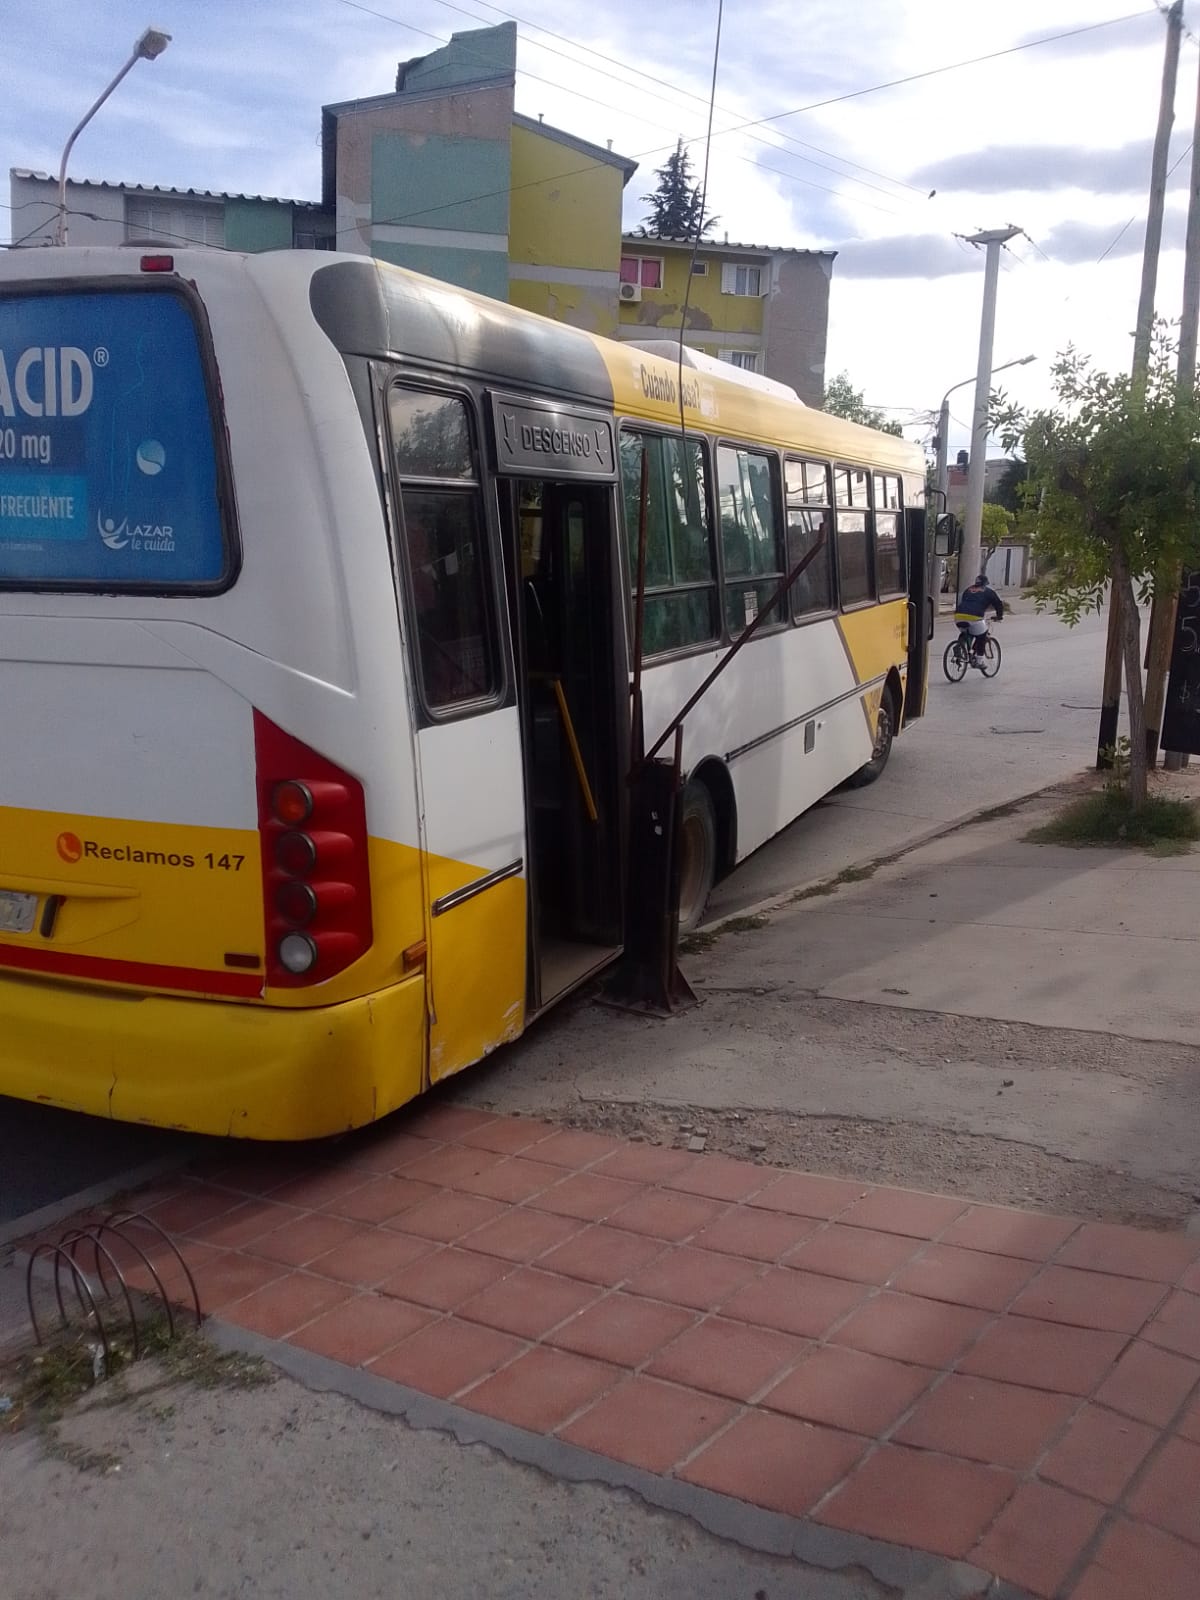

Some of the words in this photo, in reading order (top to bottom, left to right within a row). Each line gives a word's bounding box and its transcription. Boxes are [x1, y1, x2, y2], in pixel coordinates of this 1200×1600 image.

[22, 434, 50, 464] mg
[521, 425, 590, 458] DESCENSO
[0, 495, 74, 519] FRECUENTE
[126, 524, 173, 538] LAZAR
[131, 536, 142, 551] le
[144, 537, 175, 552] cuida
[84, 841, 195, 868] Reclamos
[204, 853, 245, 871] 147
